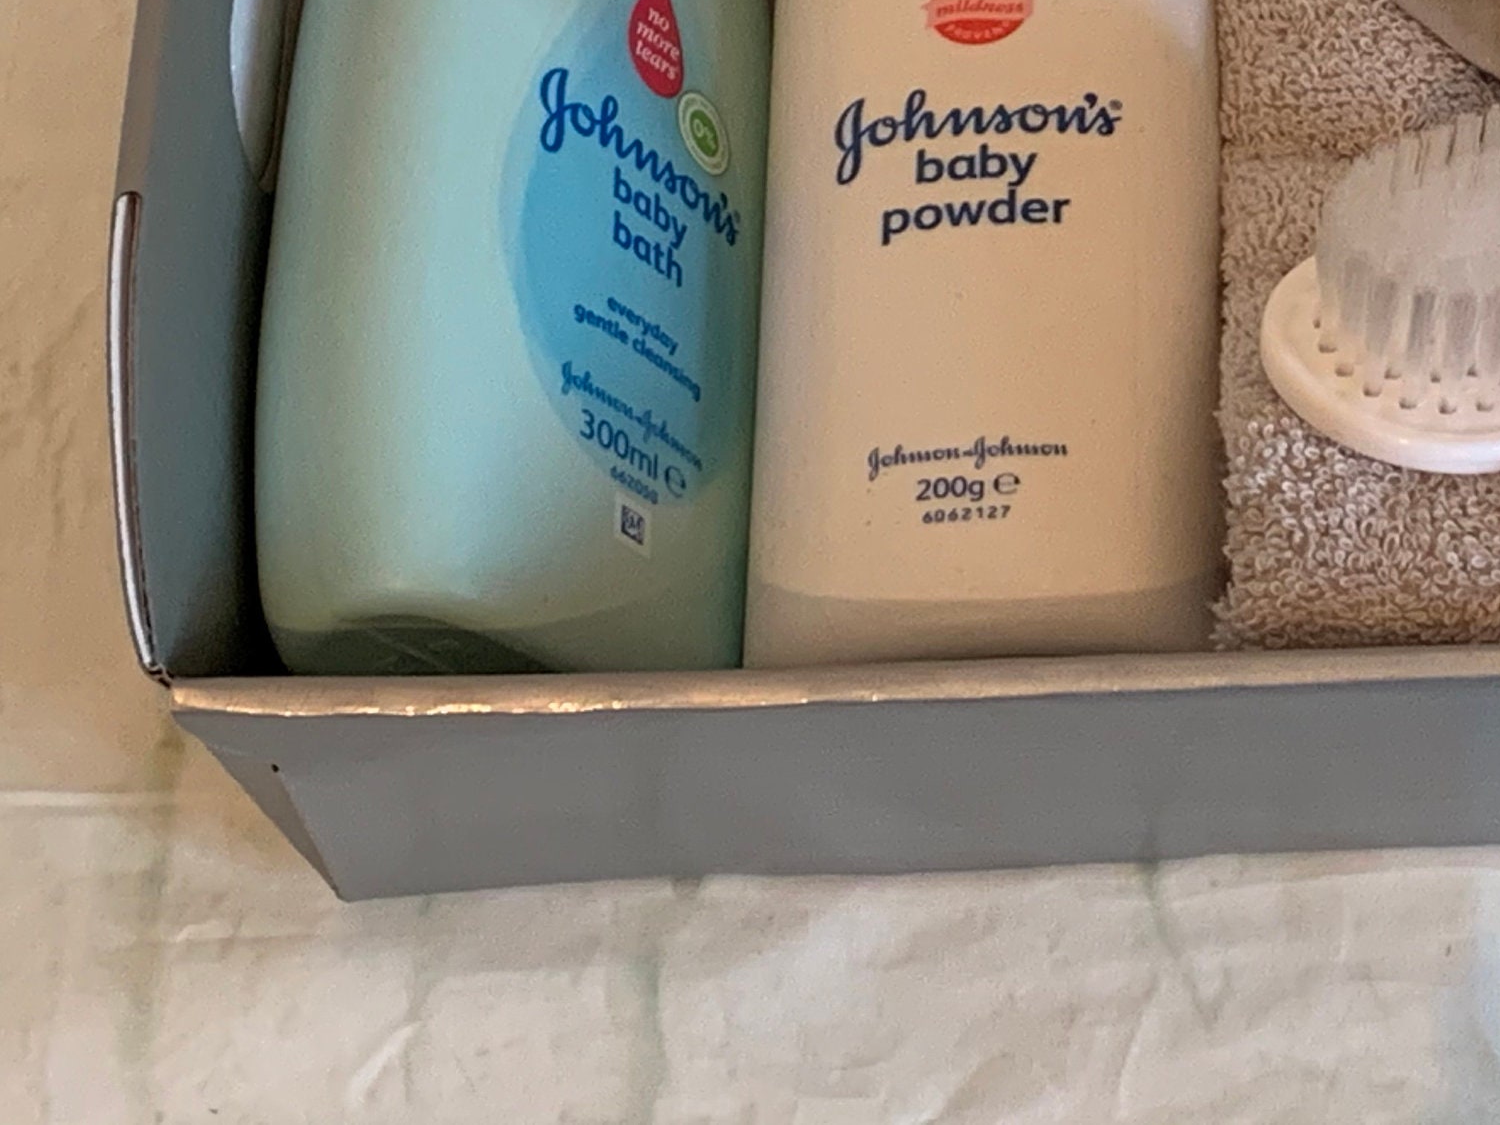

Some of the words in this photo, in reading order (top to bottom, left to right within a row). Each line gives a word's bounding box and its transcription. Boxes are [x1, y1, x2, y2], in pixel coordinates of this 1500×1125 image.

[636, 22, 680, 61] more
[648, 8, 670, 33] no
[635, 39, 677, 82] tears
[540, 68, 740, 247] Johnson's
[834, 89, 1122, 185] Johnson's
[915, 143, 1038, 187] baby
[613, 166, 688, 249] baby
[881, 189, 1071, 246] powder
[613, 210, 683, 287] bath
[573, 304, 629, 345] gentle
[632, 338, 701, 403] cleansing
[607, 296, 679, 356] everyday
[580, 408, 659, 480] 300ml
[915, 476, 986, 502] 200g
[922, 504, 1011, 524] 6062127
